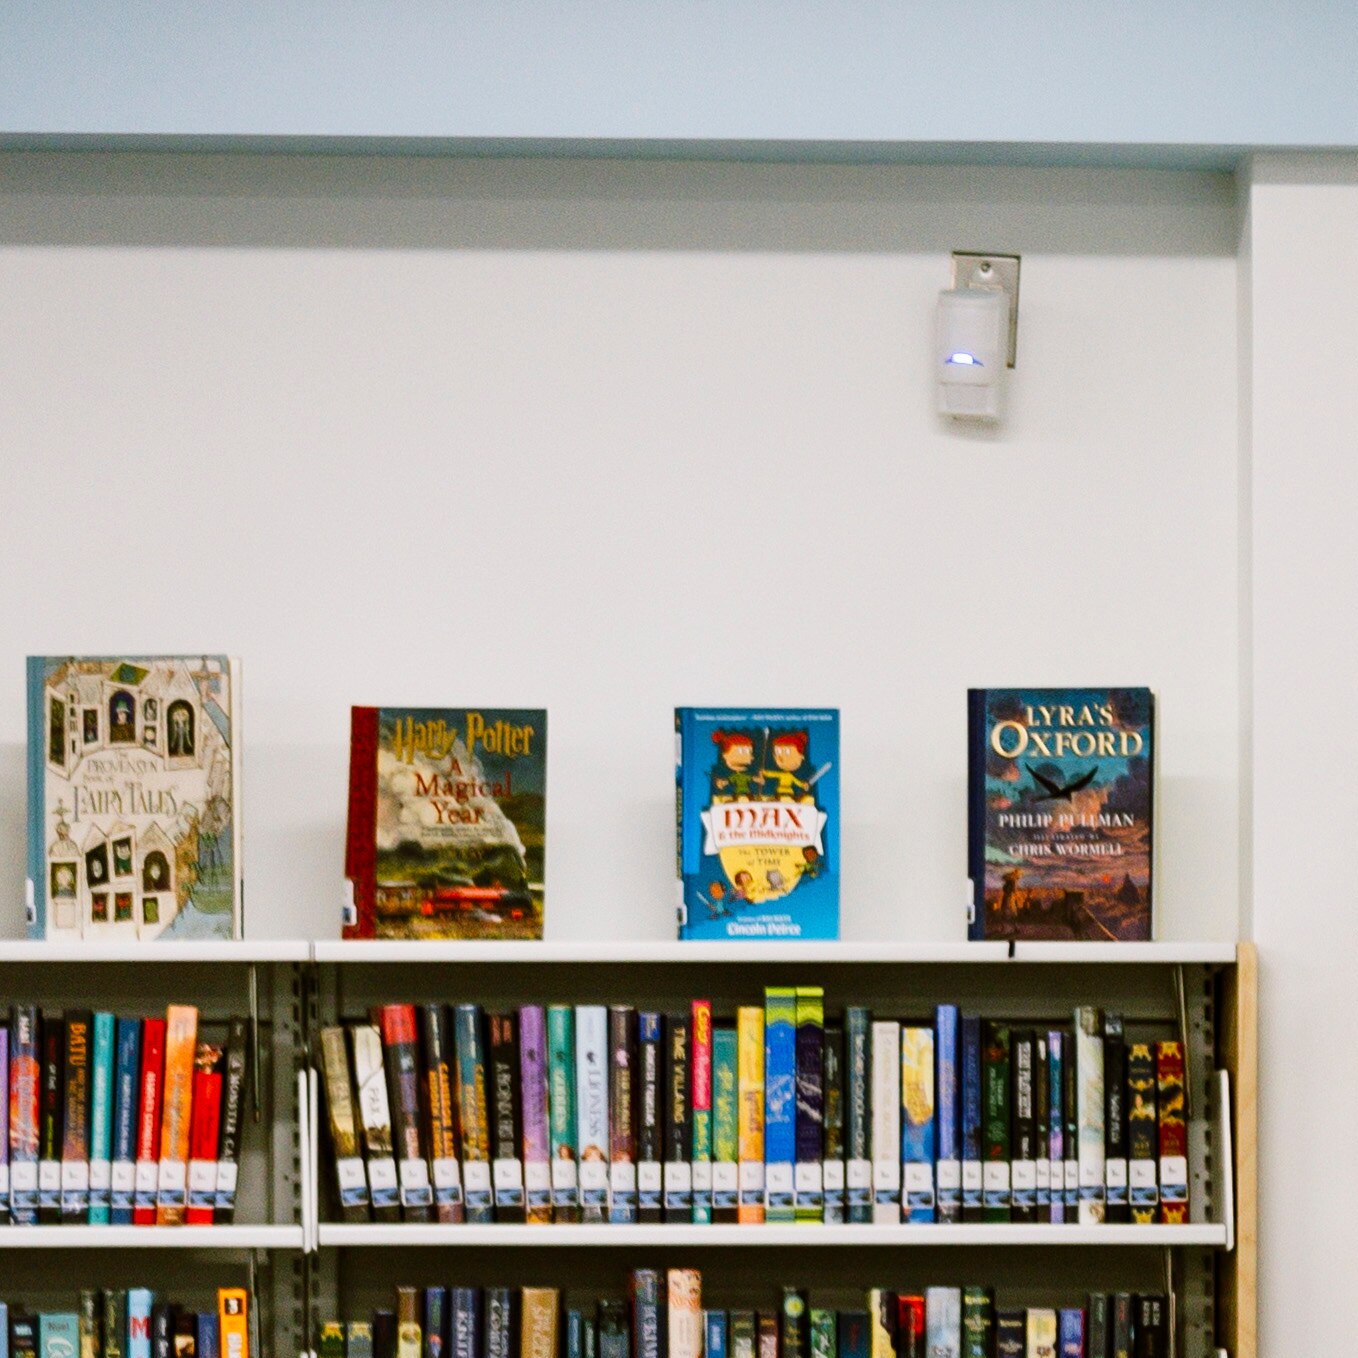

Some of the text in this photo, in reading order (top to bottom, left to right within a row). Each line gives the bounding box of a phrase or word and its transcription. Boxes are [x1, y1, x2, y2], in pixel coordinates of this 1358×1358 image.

[1026, 703, 1113, 726] LYRA'S
[393, 712, 534, 765] Harry Potter
[990, 720, 1143, 759] OXFORD
[450, 758, 462, 776] A
[415, 770, 512, 804] Magical
[430, 801, 483, 824] Year
[724, 808, 802, 828] MAX
[999, 812, 1135, 828] PHILIP PULLMAN
[1008, 842, 1123, 857] CHRIS WORMELL
[69, 1022, 87, 1066] BATU
[673, 1026, 686, 1124] TIME VILLAINS
[589, 1068, 602, 1137] LIONESS
